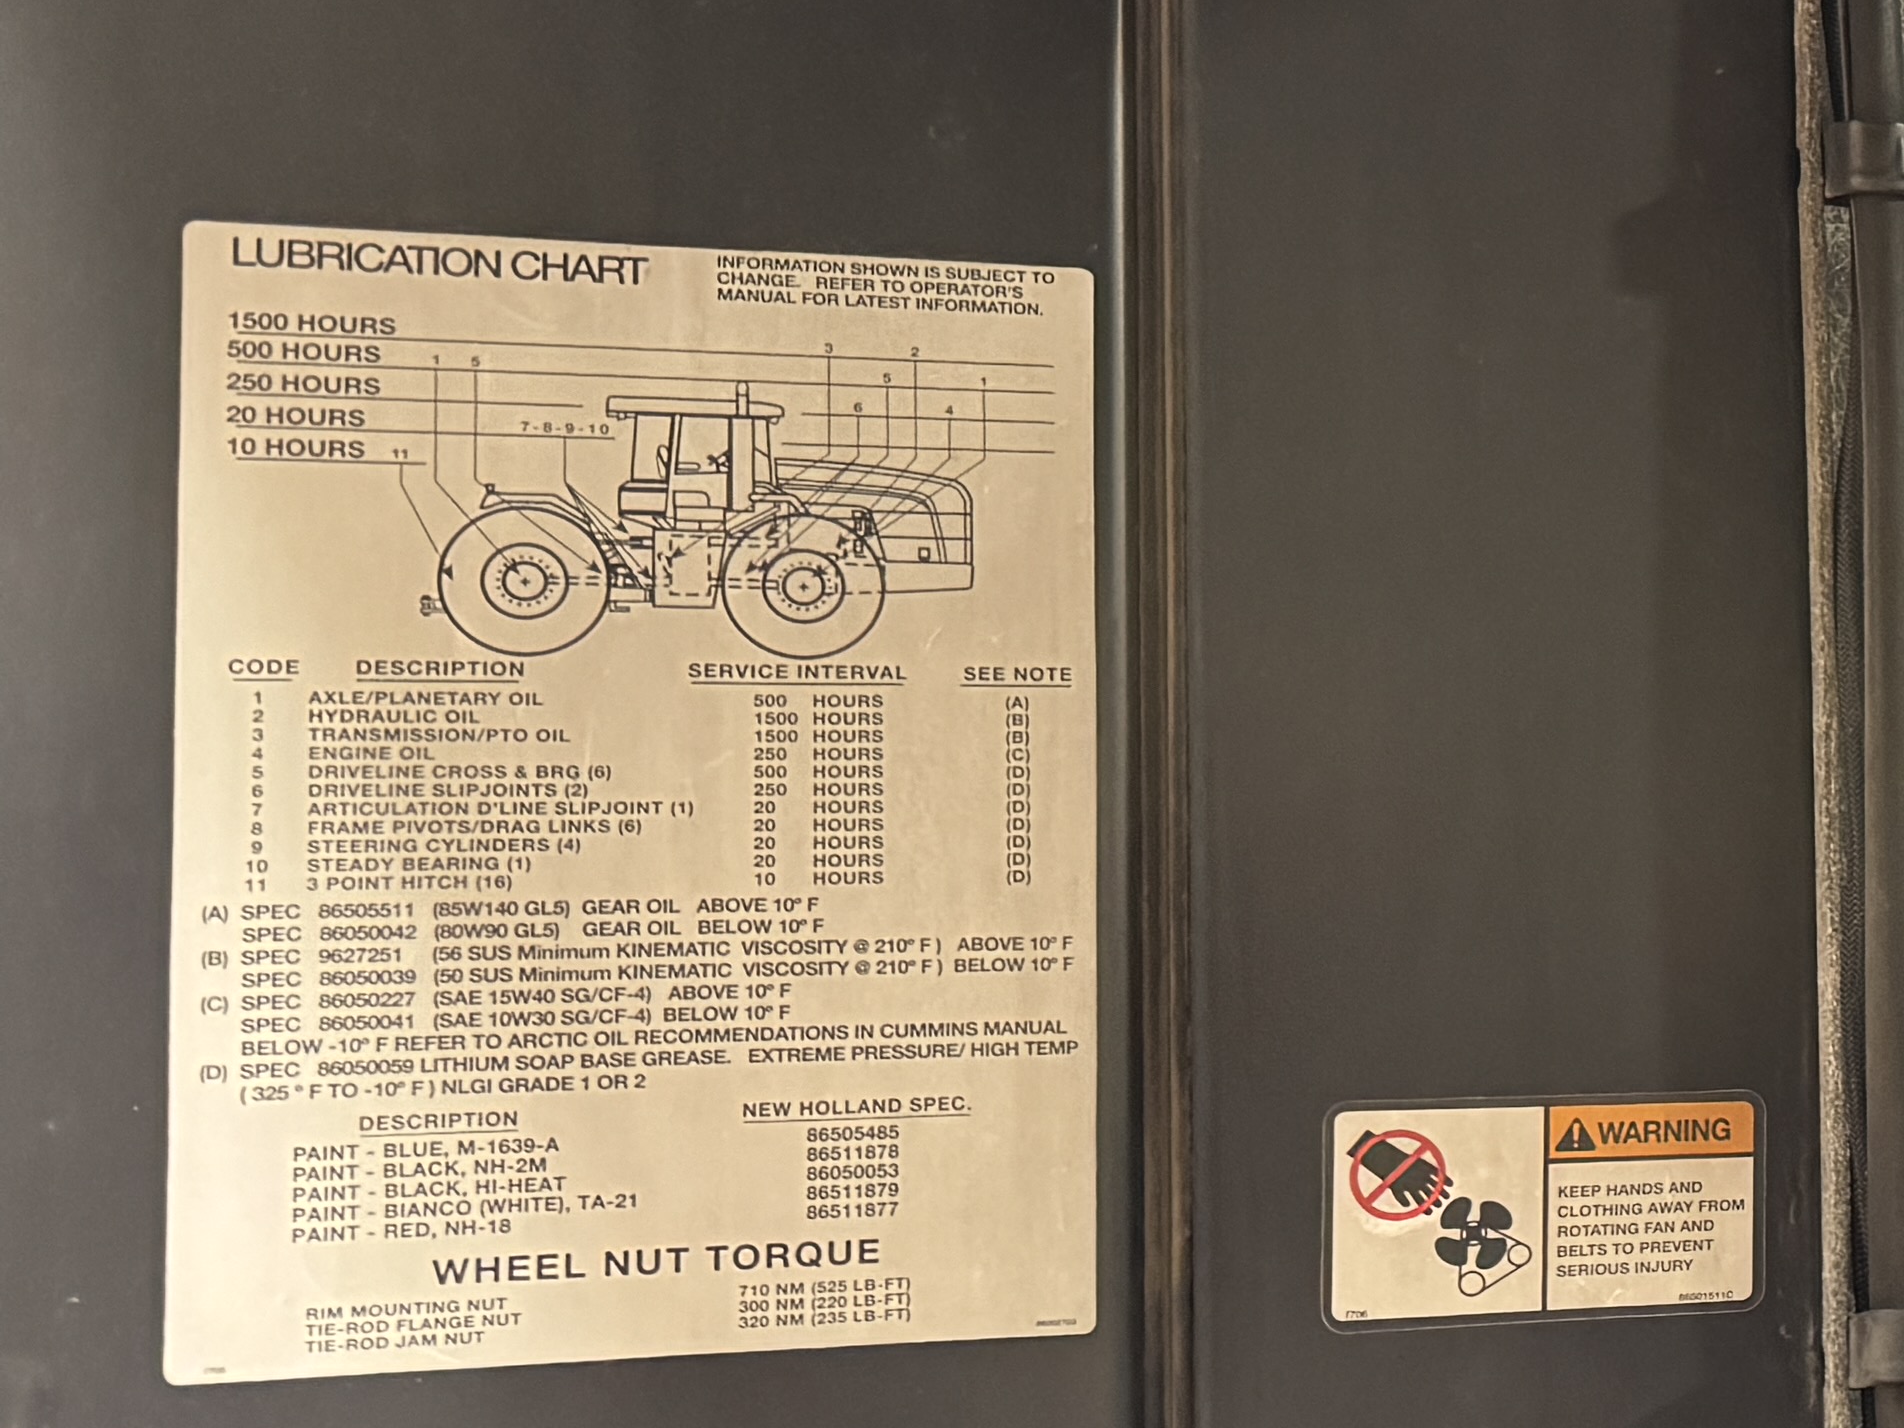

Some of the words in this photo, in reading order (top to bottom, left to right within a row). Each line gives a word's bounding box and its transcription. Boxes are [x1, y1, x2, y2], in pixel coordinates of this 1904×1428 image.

[232, 236, 502, 279] LUBRICATION
[510, 250, 650, 286] CHART
[716, 255, 845, 274] INFORMATION
[850, 262, 919, 278] SHOWN
[924, 266, 941, 279] IS
[945, 266, 1027, 283] SUBJECT
[1031, 271, 1055, 285] TO
[815, 275, 875, 292] REFER
[880, 279, 905, 294] TO
[909, 280, 1024, 299] OPERATOR'S
[717, 287, 797, 305] MANUAL
[801, 291, 839, 307] FOR
[844, 294, 911, 310] LATEST
[228, 311, 289, 331] 1500
[297, 313, 396, 336] HOURS
[226, 339, 273, 360] 500
[281, 342, 381, 364] HOURS
[227, 437, 256, 456] 10
[265, 438, 365, 460] HOURS
[228, 658, 300, 675] CODE
[356, 659, 525, 677] DESCRIPTION
[687, 662, 788, 680] SERVICE
[797, 664, 907, 680] INTERVAL
[963, 666, 1005, 682] SEE
[1013, 666, 1072, 682] NOTE
[308, 690, 502, 706] AXLE/PLANETARY
[508, 691, 545, 707] OIL
[309, 708, 438, 724] HYDRAULIC
[444, 709, 481, 725] OIL
[309, 727, 529, 743] TRANSMISSION/PTO
[535, 728, 571, 743] OIL
[308, 745, 392, 761] ENGINE
[399, 745, 436, 761] OIL
[308, 764, 425, 780] DRIVELINE
[431, 764, 508, 780] CROSS
[535, 764, 581, 781] BRG
[308, 783, 425, 798] DRIVELINE
[431, 782, 558, 798] SLIPJOINTS
[308, 801, 469, 817] ARTICULATION
[477, 801, 548, 816] D'LINE
[554, 800, 664, 816] SLIPJOINT
[308, 820, 384, 835] FRAME
[392, 819, 541, 835] PIVOTS/DRAG
[548, 819, 611, 834] LINKS
[307, 838, 418, 854] STEERING
[425, 837, 551, 853] CYLINDERS
[307, 857, 395, 873] STEADY
[402, 856, 500, 872] BEARING
[326, 875, 395, 891] POINT
[401, 874, 468, 890] HITCH
[241, 904, 300, 921] SPEC
[318, 902, 413, 919] 86505511
[581, 898, 640, 916] GEAR
[646, 898, 681, 914] OIL
[695, 897, 768, 914] ABOVE
[240, 949, 300, 966] SPEC
[318, 947, 401, 964] 9627251
[467, 944, 512, 962] SUS
[517, 943, 610, 961] Minimum
[616, 940, 731, 959] KINEMATIC
[740, 939, 848, 956] VISCOSITY
[956, 936, 1025, 952] ABOVE
[241, 993, 301, 1011] SPEC
[318, 991, 416, 1009] 86050227
[488, 988, 556, 1005] 15W40
[667, 983, 739, 1001] ABOVE
[241, 1039, 323, 1056] BELOW
[394, 1034, 466, 1052] REFER
[471, 1033, 502, 1050] TO
[507, 1031, 588, 1049] ARCTIC
[593, 1030, 629, 1047] OIL
[634, 1024, 849, 1046] RECOMMENDATIONS
[854, 1024, 874, 1040] IN
[879, 1021, 979, 1039] CUMMINS
[983, 1019, 1068, 1036] MANUAL
[240, 1061, 300, 1079] SPEC
[317, 1058, 414, 1077] 86050059
[420, 1055, 509, 1074] LITHIUM
[514, 1053, 575, 1071] SOAP
[580, 1051, 637, 1069] BASE
[748, 1046, 846, 1064] EXTREME
[970, 1041, 1020, 1058] HIGH
[1023, 1039, 1079, 1057] TEMP
[742, 1101, 792, 1118] NEW
[799, 1097, 902, 1117] HOLLAND
[359, 1110, 518, 1131] DESCRIPTION
[806, 1124, 900, 1143] 86505485
[1598, 1117, 1731, 1145] WARNING
[293, 1144, 360, 1162] PAINT
[457, 1136, 560, 1156] M-1639-A
[806, 1143, 899, 1162] 86511878
[293, 1164, 360, 1182] PAINT
[474, 1156, 547, 1175] NH-2M
[806, 1162, 899, 1182] 86050053
[806, 1182, 899, 1201] 86511879
[1558, 1184, 1602, 1199] KEEP
[1606, 1181, 1664, 1197] HANDS
[1668, 1180, 1703, 1194] AND
[292, 1205, 361, 1223] PAINT
[384, 1199, 472, 1219] BIANCO
[576, 1192, 637, 1211] TA-21
[806, 1201, 899, 1220] 86511877
[1557, 1202, 1643, 1219] CLOTHING
[1647, 1200, 1694, 1214] AWAY
[1698, 1198, 1745, 1213] FROM
[292, 1224, 361, 1243] PAINT
[444, 1218, 512, 1236] NH-18
[1557, 1222, 1640, 1238] ROTATING
[1644, 1220, 1676, 1235] FAN
[1680, 1219, 1715, 1233] AND
[1557, 1243, 1608, 1258] BELTS
[1611, 1242, 1635, 1255] TO
[1639, 1238, 1715, 1254] PREVENT
[432, 1252, 587, 1285] WHEEL
[604, 1247, 690, 1277] NUT
[705, 1238, 880, 1272] TORQUE
[1556, 1261, 1631, 1278] SERIOUS
[1634, 1258, 1694, 1274] INJURY
[738, 1283, 770, 1298] 710
[775, 1281, 805, 1296] NM
[306, 1306, 343, 1320] RIM
[351, 1299, 461, 1318] MOUNTING
[467, 1297, 508, 1312] NUT
[738, 1299, 770, 1314] 300
[775, 1297, 805, 1312] NM
[305, 1319, 390, 1337] TIE-ROD
[396, 1314, 475, 1332] FLANGE
[481, 1312, 523, 1327] NUT
